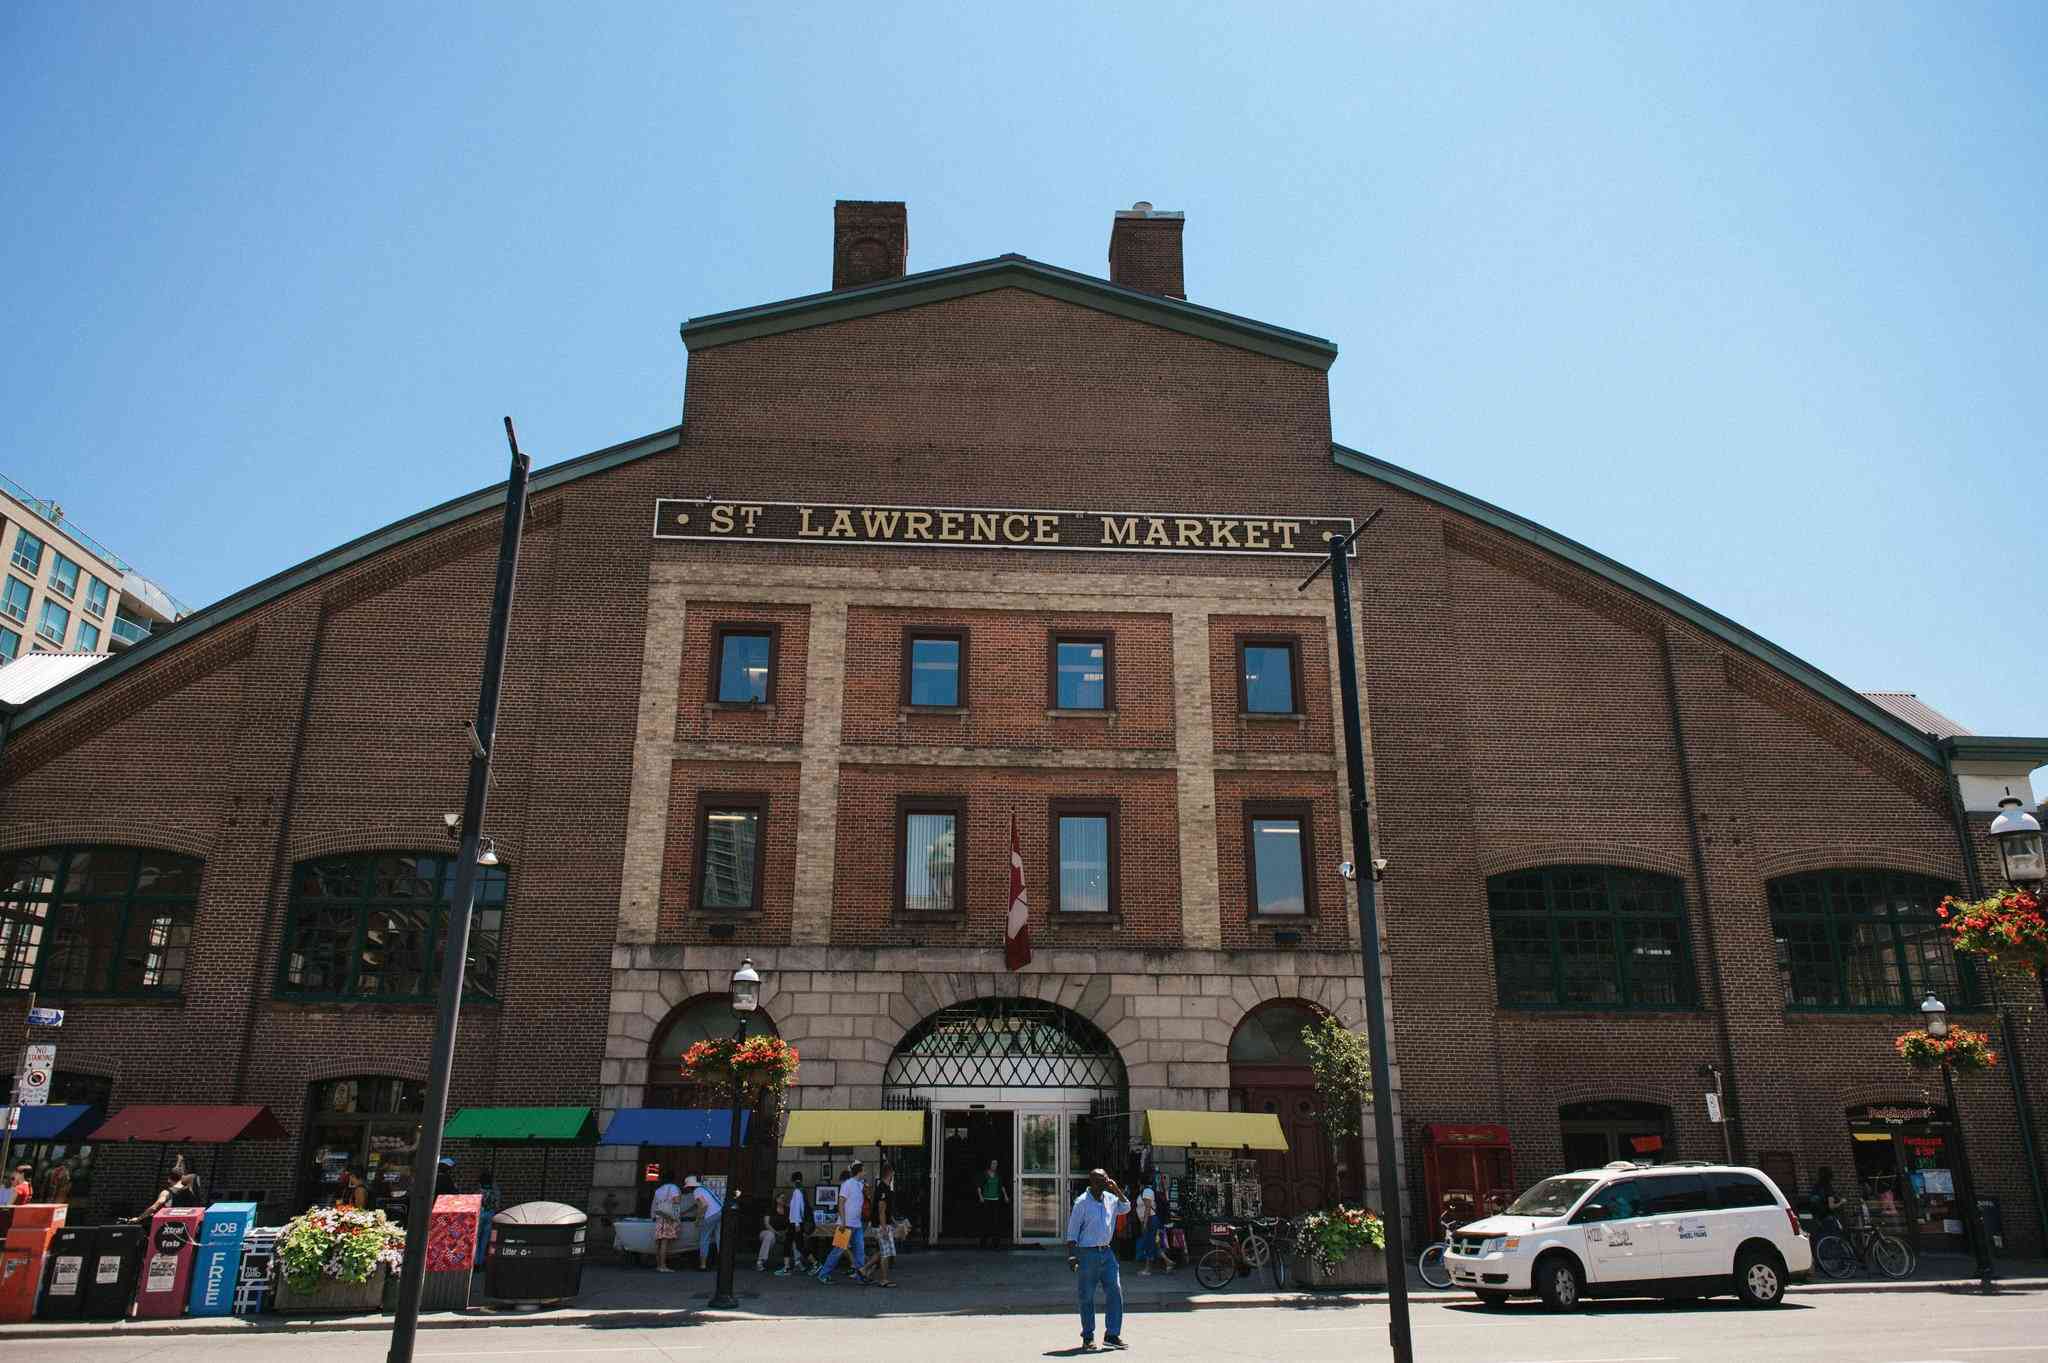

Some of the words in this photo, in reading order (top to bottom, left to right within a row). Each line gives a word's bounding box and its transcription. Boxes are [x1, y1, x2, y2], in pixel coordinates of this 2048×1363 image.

[798, 508, 1060, 543] LAWRENCE
[1100, 516, 1301, 549] MARKET
[35, 1046, 48, 1054] NO
[210, 1222, 238, 1233] JOB
[161, 1239, 181, 1248] fab
[502, 1247, 518, 1256] Litter
[204, 1252, 226, 1306] FREE
